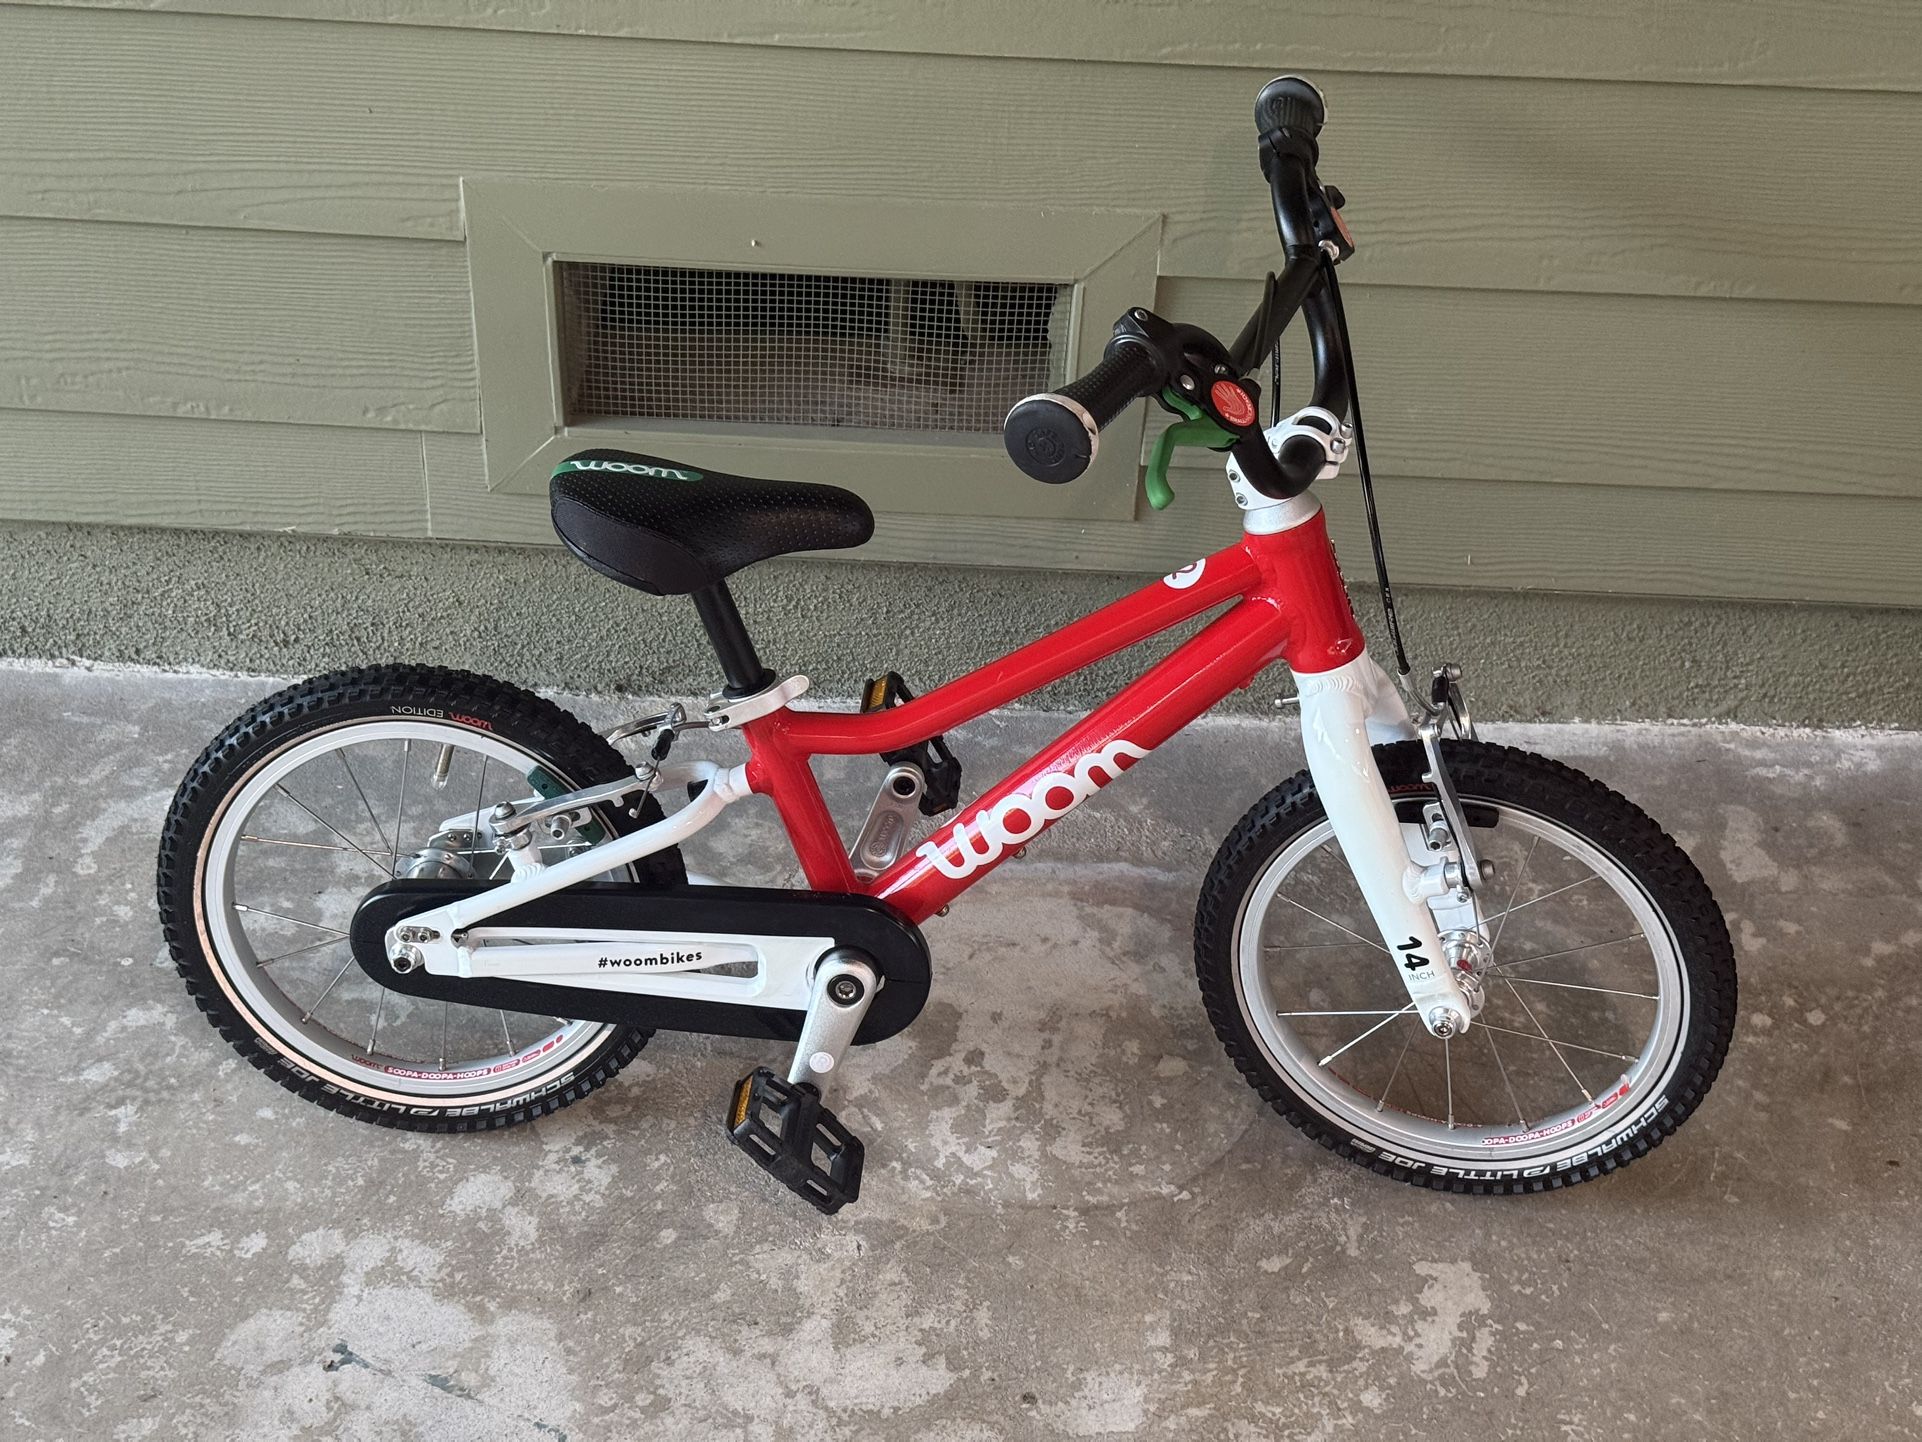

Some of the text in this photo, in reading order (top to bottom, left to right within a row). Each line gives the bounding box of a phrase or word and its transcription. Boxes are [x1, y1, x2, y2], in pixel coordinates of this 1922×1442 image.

[570, 461, 688, 480] woom
[390, 705, 493, 731] woom EDITION
[915, 739, 1152, 879] woom
[598, 951, 703, 969] #woombikes
[1396, 936, 1430, 971] 14
[1408, 970, 1435, 981] INCH
[278, 1058, 576, 1118] SCHWALBE LITTLE JOE
[1557, 1095, 1669, 1171] SCHWALBE
[1379, 1152, 1425, 1172] JOE
[1430, 1166, 1518, 1180] LITTLE
